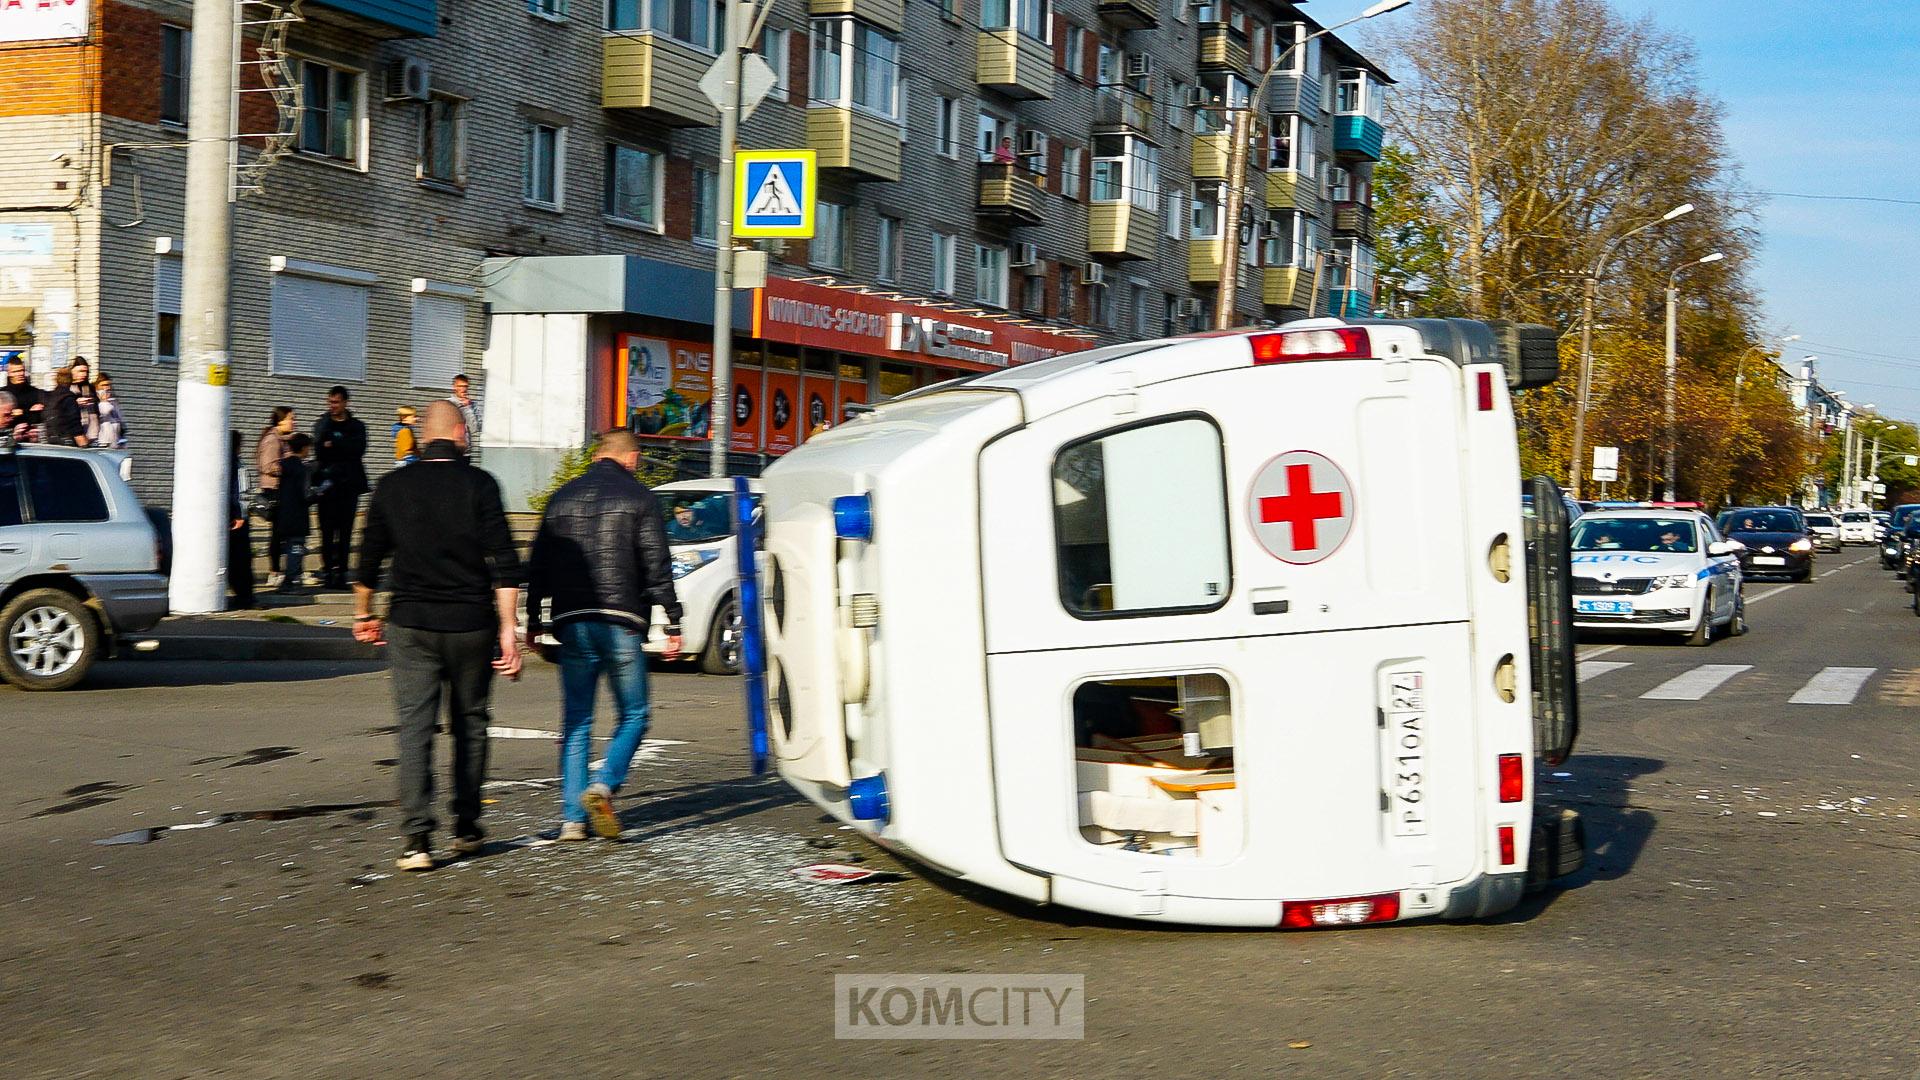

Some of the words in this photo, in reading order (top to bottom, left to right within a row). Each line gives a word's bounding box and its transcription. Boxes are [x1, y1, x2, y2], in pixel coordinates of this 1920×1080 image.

[890, 312, 950, 356] DNS
[675, 349, 711, 373] DNS
[1571, 553, 1660, 565] ДПС
